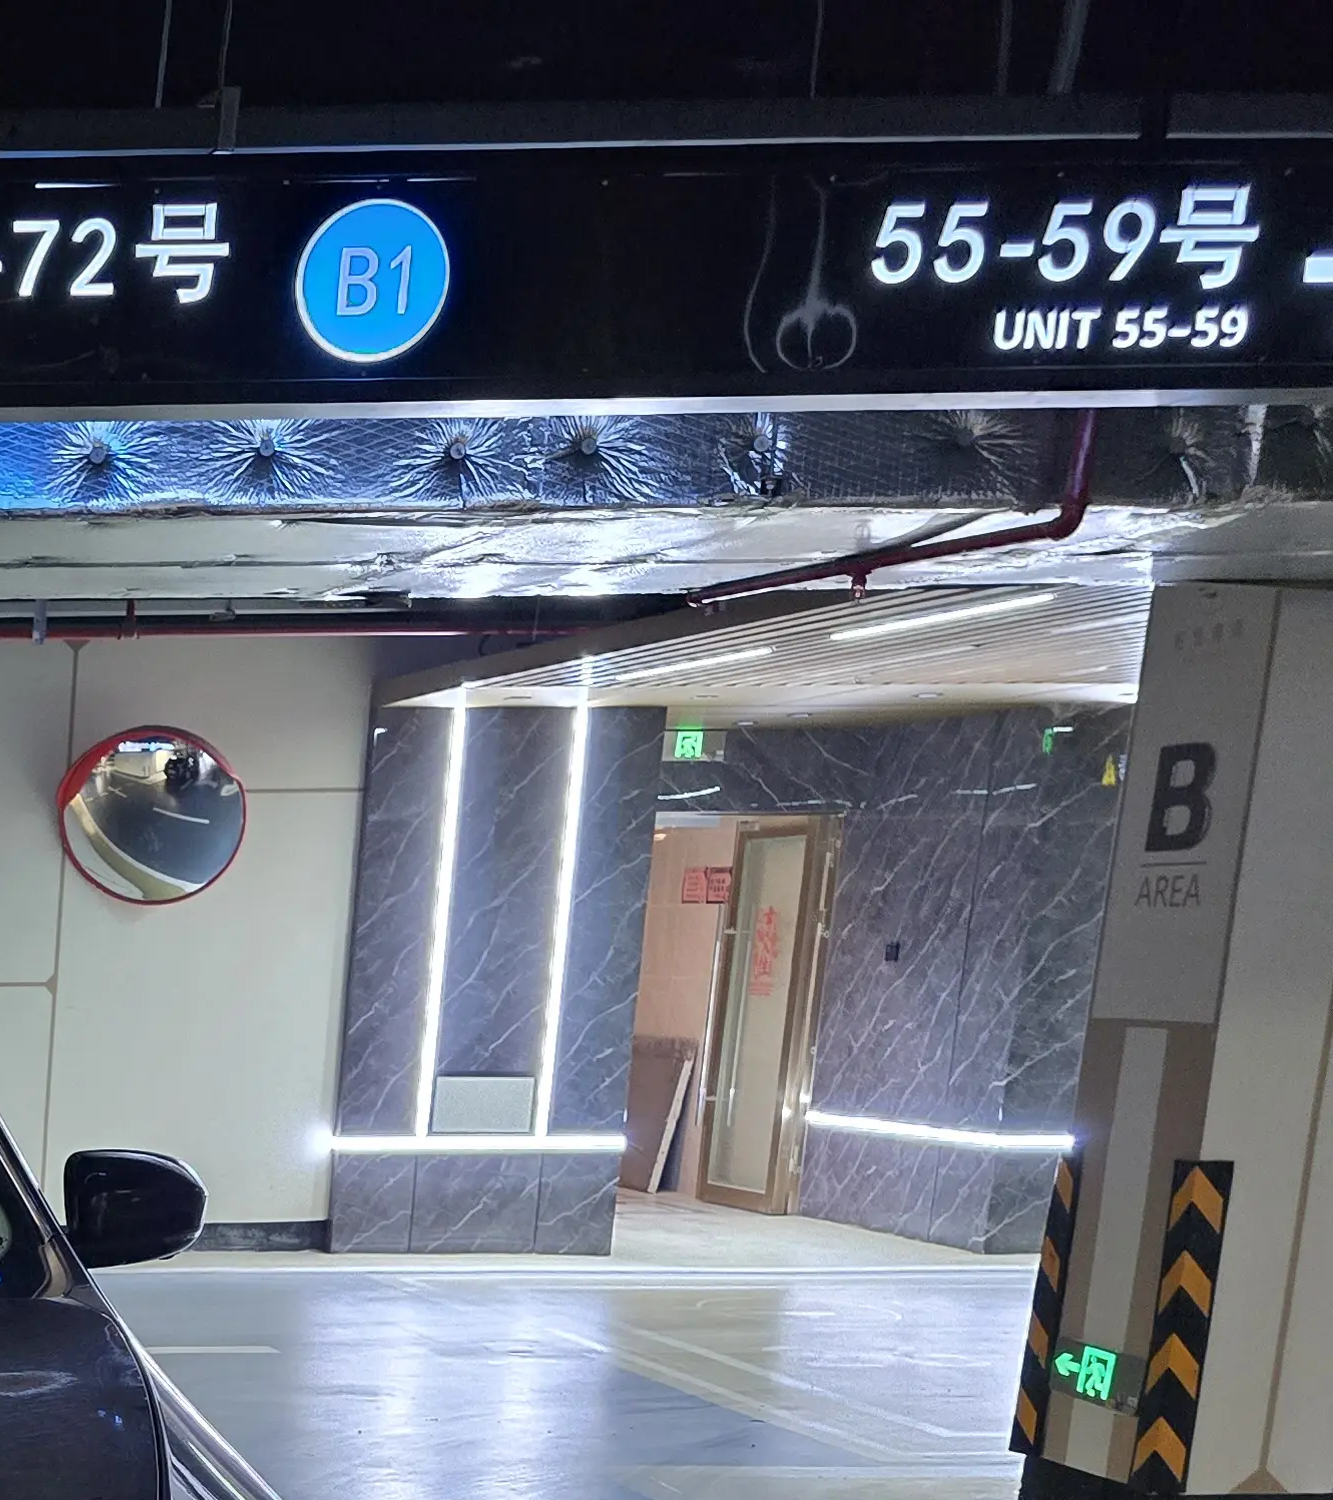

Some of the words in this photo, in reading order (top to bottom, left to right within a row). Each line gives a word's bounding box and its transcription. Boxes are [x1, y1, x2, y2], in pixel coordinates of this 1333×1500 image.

[870, 185, 1260, 290] 55-59号
[336, 245, 412, 316] B1
[993, 307, 1102, 351] UNIT
[1112, 306, 1249, 349] 55-59
[1144, 742, 1217, 852] B
[1134, 873, 1201, 908] AREA
